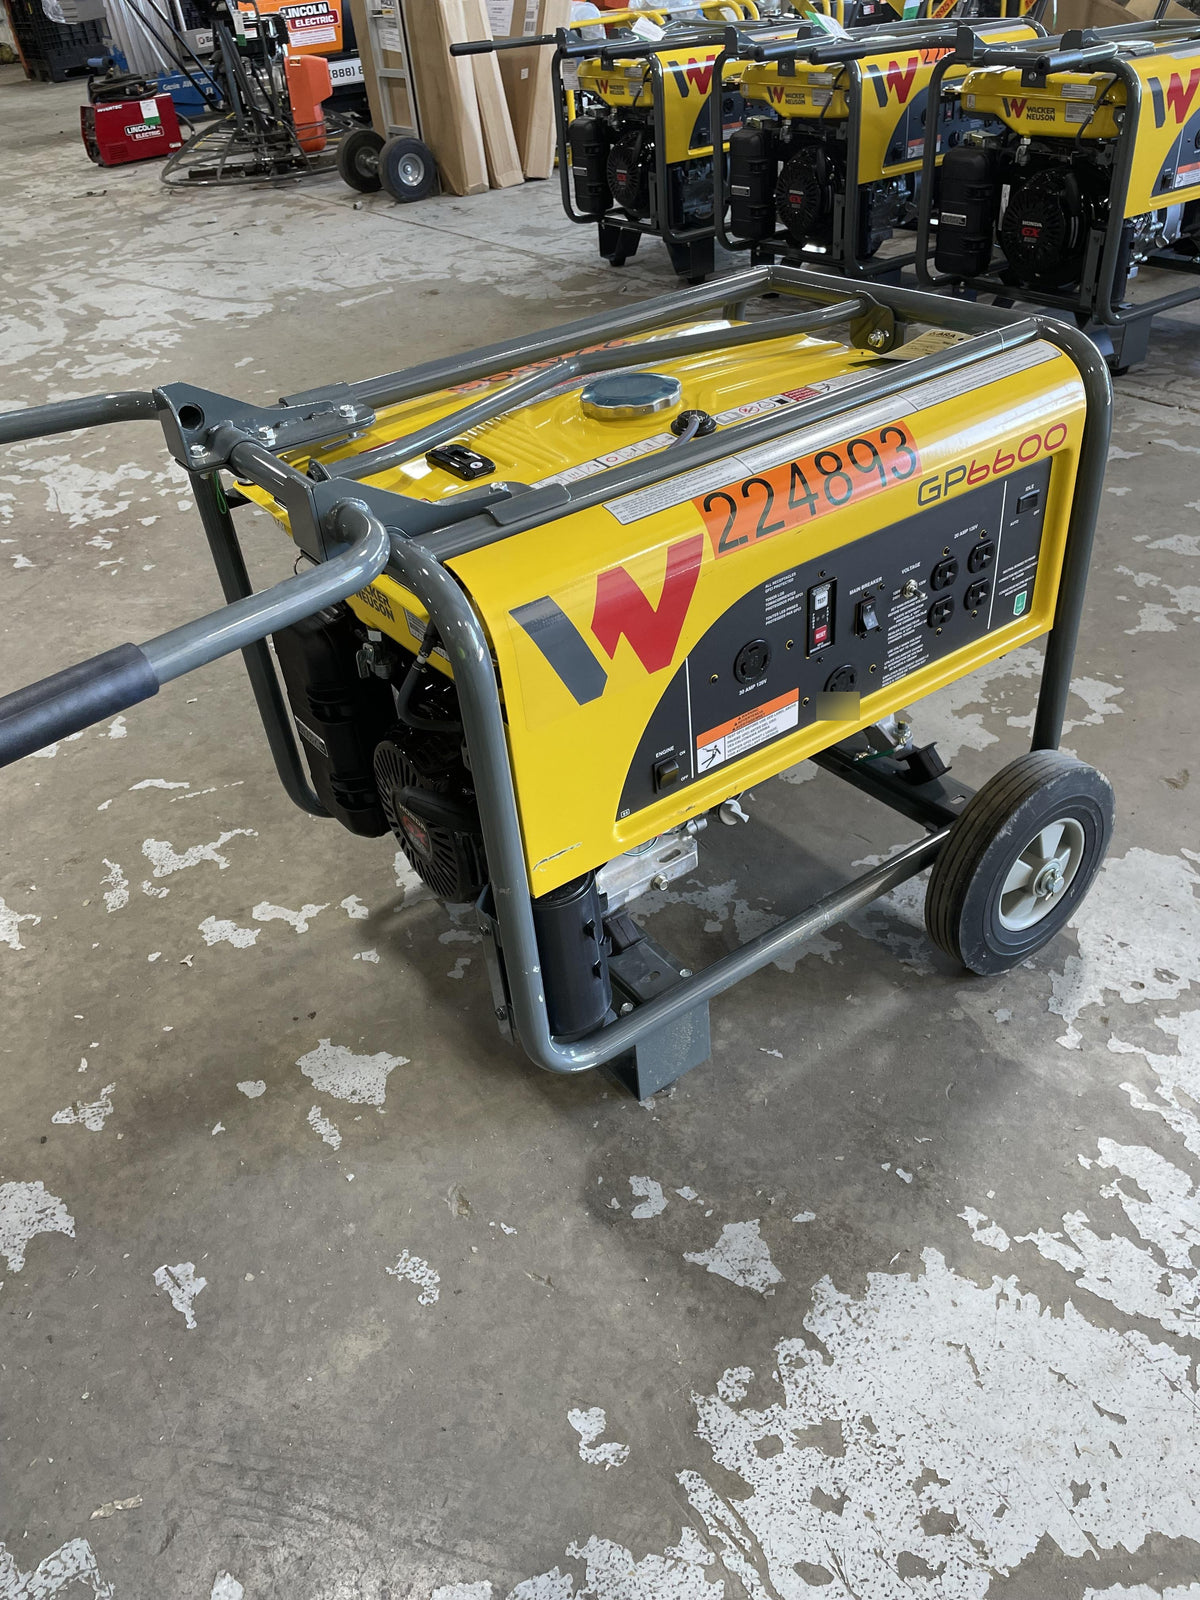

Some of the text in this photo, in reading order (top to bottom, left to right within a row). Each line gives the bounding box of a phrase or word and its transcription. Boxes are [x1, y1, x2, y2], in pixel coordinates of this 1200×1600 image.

[282, 2, 328, 19] LINCOLN
[296, 14, 334, 27] ELECTRIC
[1026, 106, 1056, 114] WACKER
[1026, 114, 1056, 122] NEUSON
[126, 124, 156, 134] LINCOLN
[136, 130, 160, 139] ELECTRIC
[918, 423, 1068, 506] GP6600
[703, 426, 917, 554] 224893
[1025, 484, 1035, 492] IDLE
[960, 528, 968, 536] AMP
[902, 561, 920, 574] VOLTAGE
[849, 576, 882, 596] MAIN BREAKER
[745, 685, 755, 693] AMP
[756, 679, 767, 687] 120V
[656, 745, 675, 758] ENGINE
